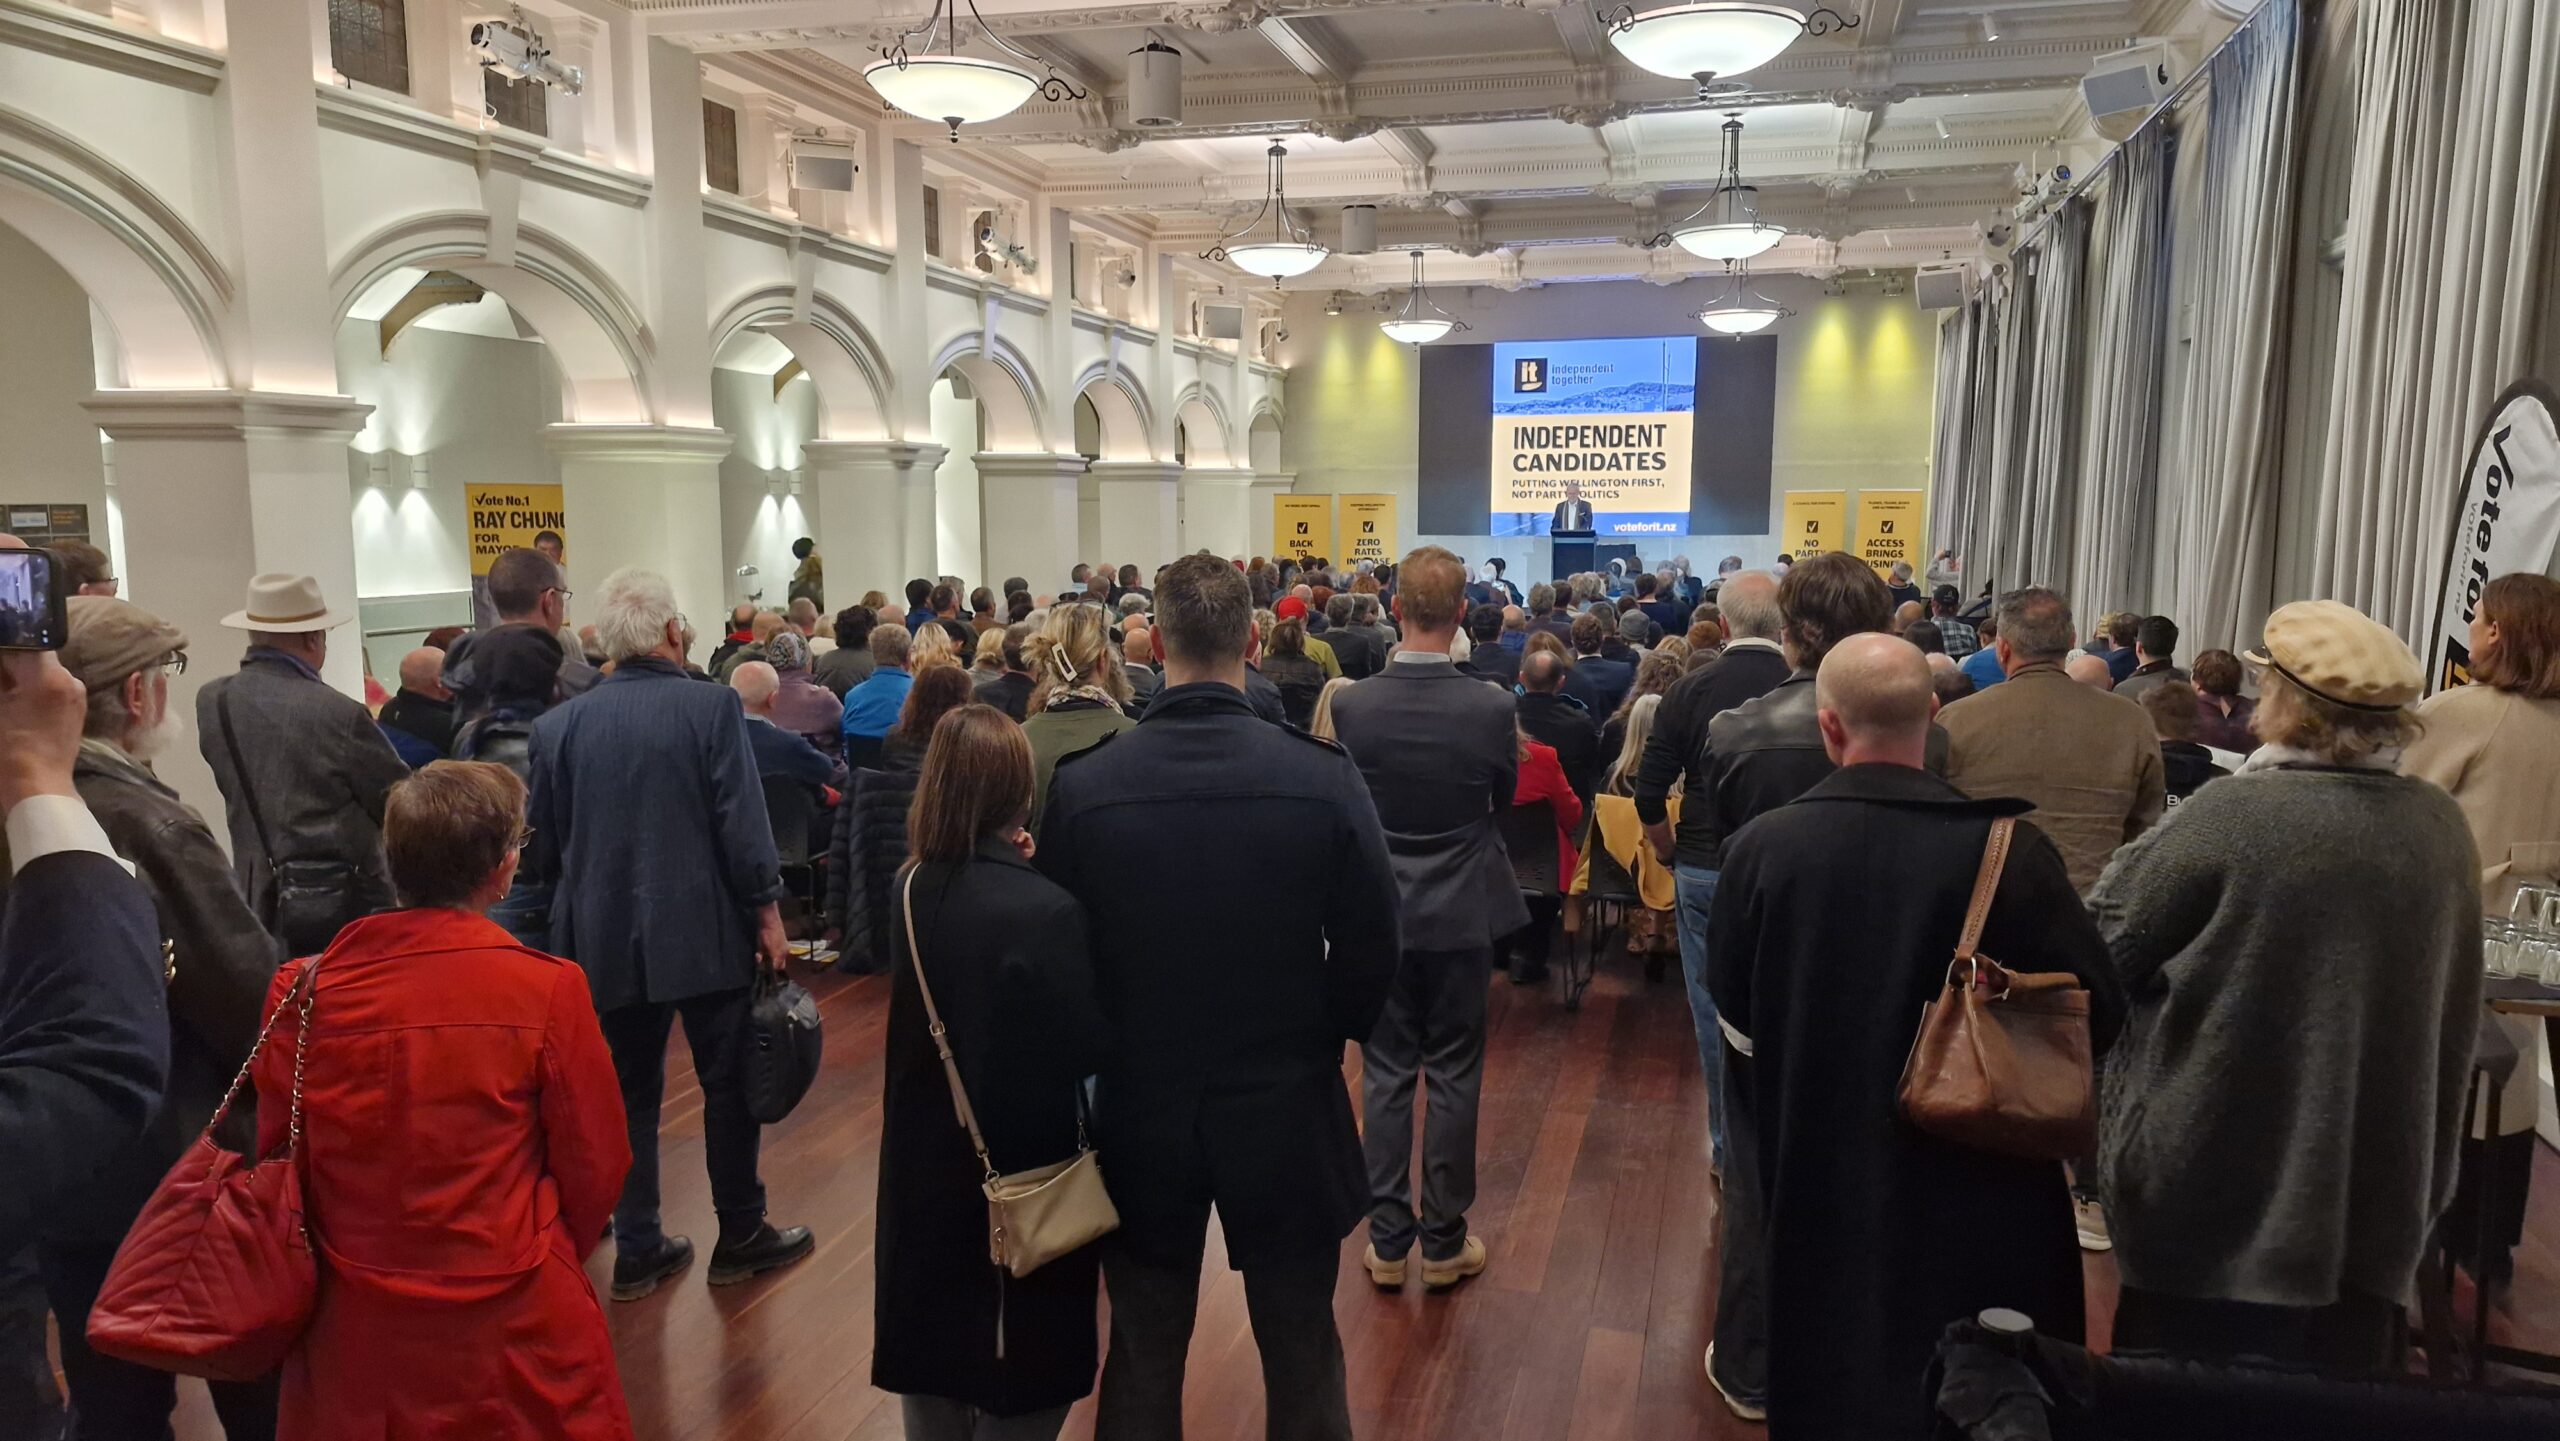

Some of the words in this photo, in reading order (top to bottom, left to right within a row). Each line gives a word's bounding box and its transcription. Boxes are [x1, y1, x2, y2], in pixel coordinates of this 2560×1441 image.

[1551, 363, 1614, 375] independent
[1551, 374, 1594, 387] together
[1513, 424, 1667, 450] INDEPENDENT
[1513, 452, 1667, 472] CANDIDATES
[1512, 479, 1557, 488] PUTTING
[1631, 478, 1665, 488] FIRST,
[1512, 490, 1533, 499] NOT
[1579, 490, 1620, 499] OLITICS
[506, 495, 530, 506] No.1
[474, 511, 507, 529] RAY
[1613, 522, 1677, 533] voteforit.nz
[475, 533, 500, 544] FOR
[1356, 538, 1381, 547] ZERO
[1804, 539, 1819, 548] NO
[1866, 539, 1905, 548] ACCESS
[1289, 540, 1313, 548] BACK
[1296, 549, 1307, 557] TO
[1354, 548, 1383, 556] RATES
[1865, 549, 1904, 558] BRINGS
